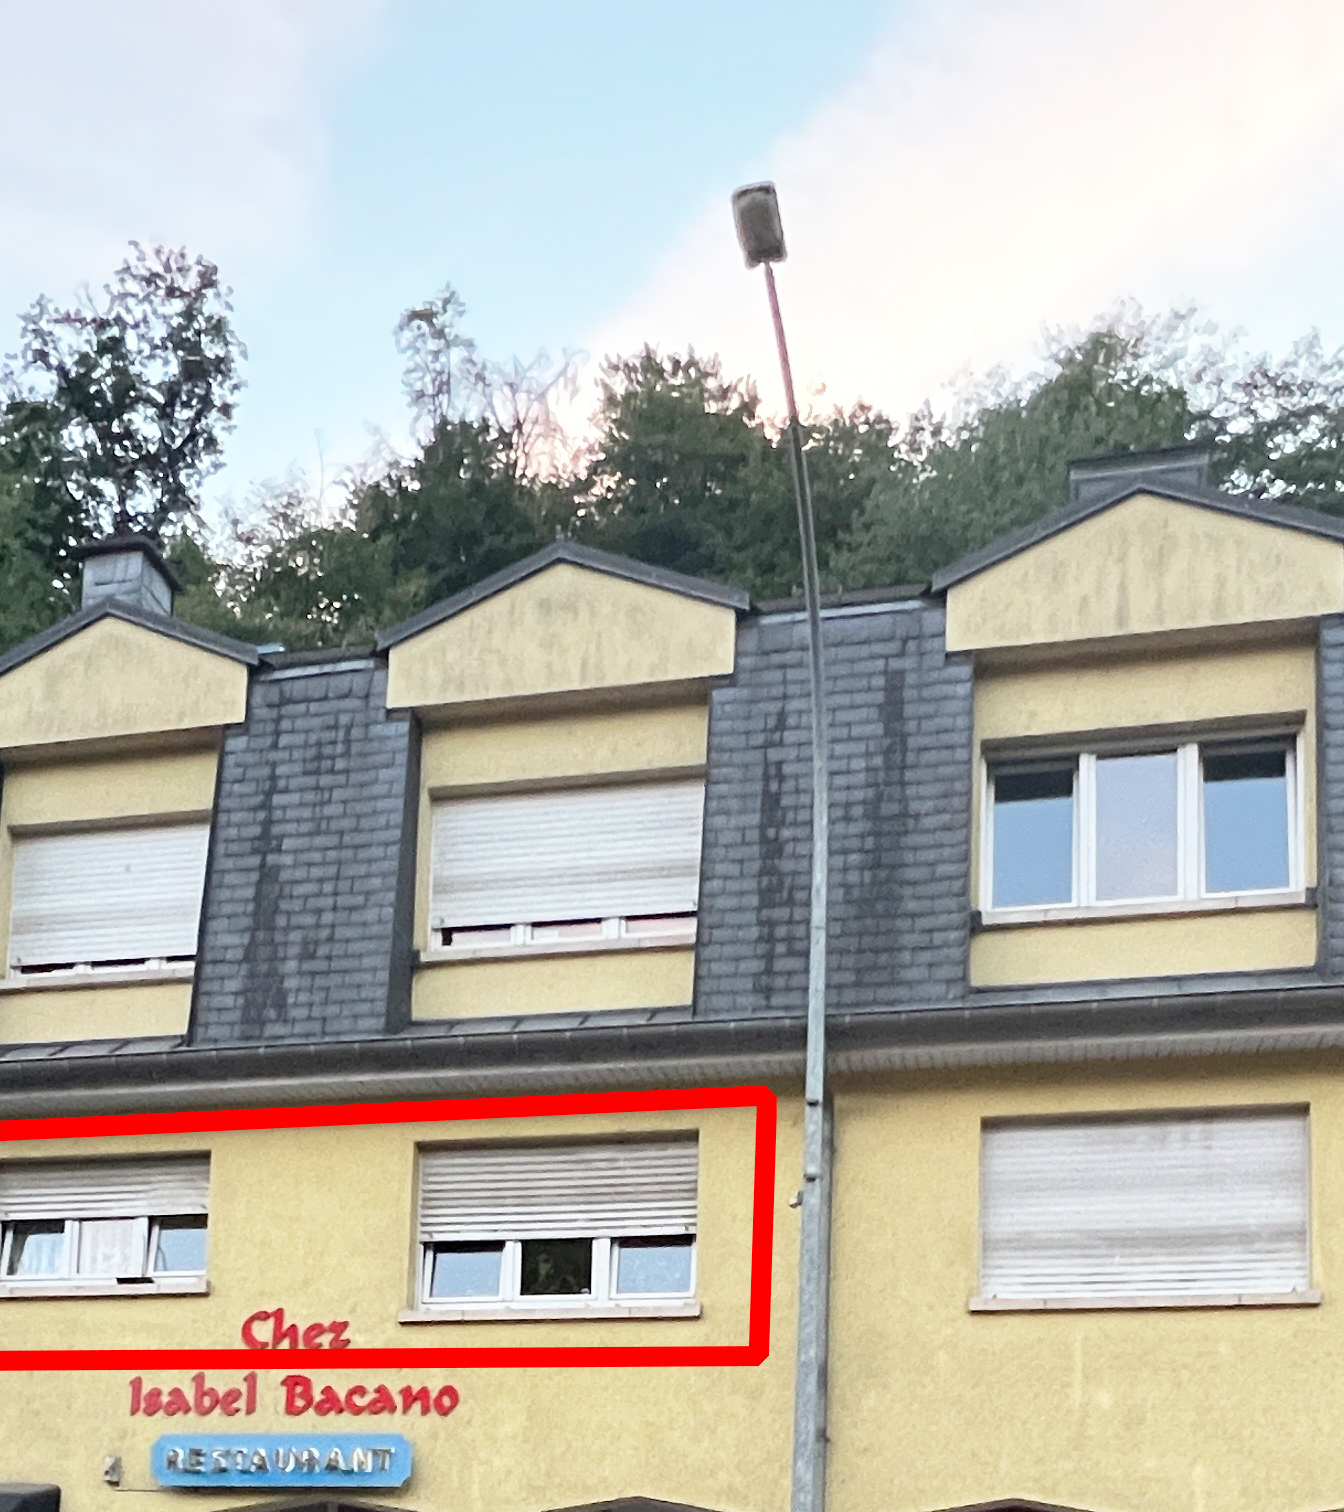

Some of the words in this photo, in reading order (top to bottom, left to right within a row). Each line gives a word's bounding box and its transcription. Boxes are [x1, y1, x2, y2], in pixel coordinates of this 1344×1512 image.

[241, 1307, 351, 1350] Chez
[129, 1371, 257, 1417] Isabel
[279, 1374, 460, 1417] Bacano
[166, 1448, 395, 1473] RESTAURANT
